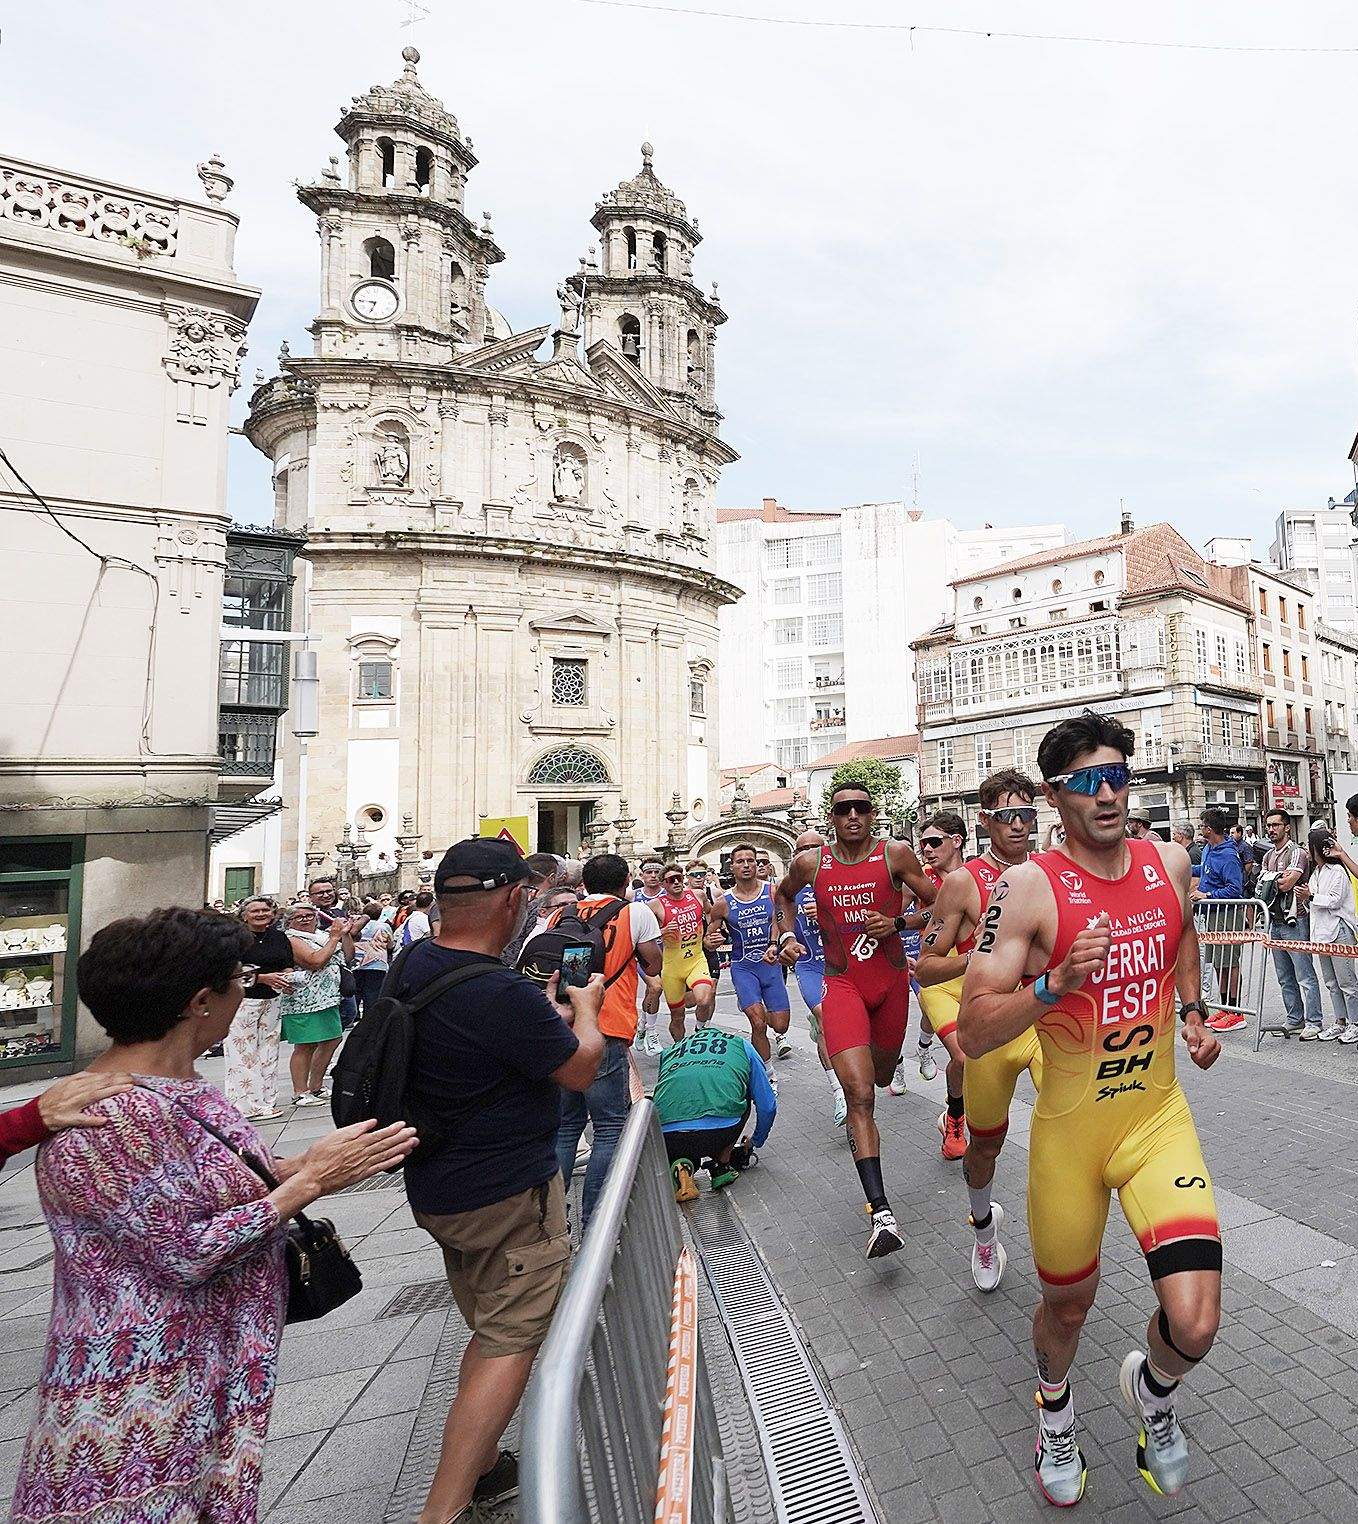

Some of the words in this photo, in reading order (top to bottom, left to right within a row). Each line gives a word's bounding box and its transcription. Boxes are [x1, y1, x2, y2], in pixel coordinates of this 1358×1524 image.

[843, 881, 877, 891] Academy
[832, 891, 875, 907] NEMSI
[678, 910, 697, 924] GRAU
[738, 904, 765, 917] NOYON
[680, 921, 698, 935] ESP
[1108, 918, 1122, 930] LA
[1111, 928, 1132, 938] CIUDAD
[1144, 919, 1167, 930] DEPORTE
[747, 927, 764, 938] FRA
[1101, 978, 1157, 1025] ESP
[1095, 1051, 1154, 1081] BH
[1095, 1079, 1147, 1102] Spiuk
